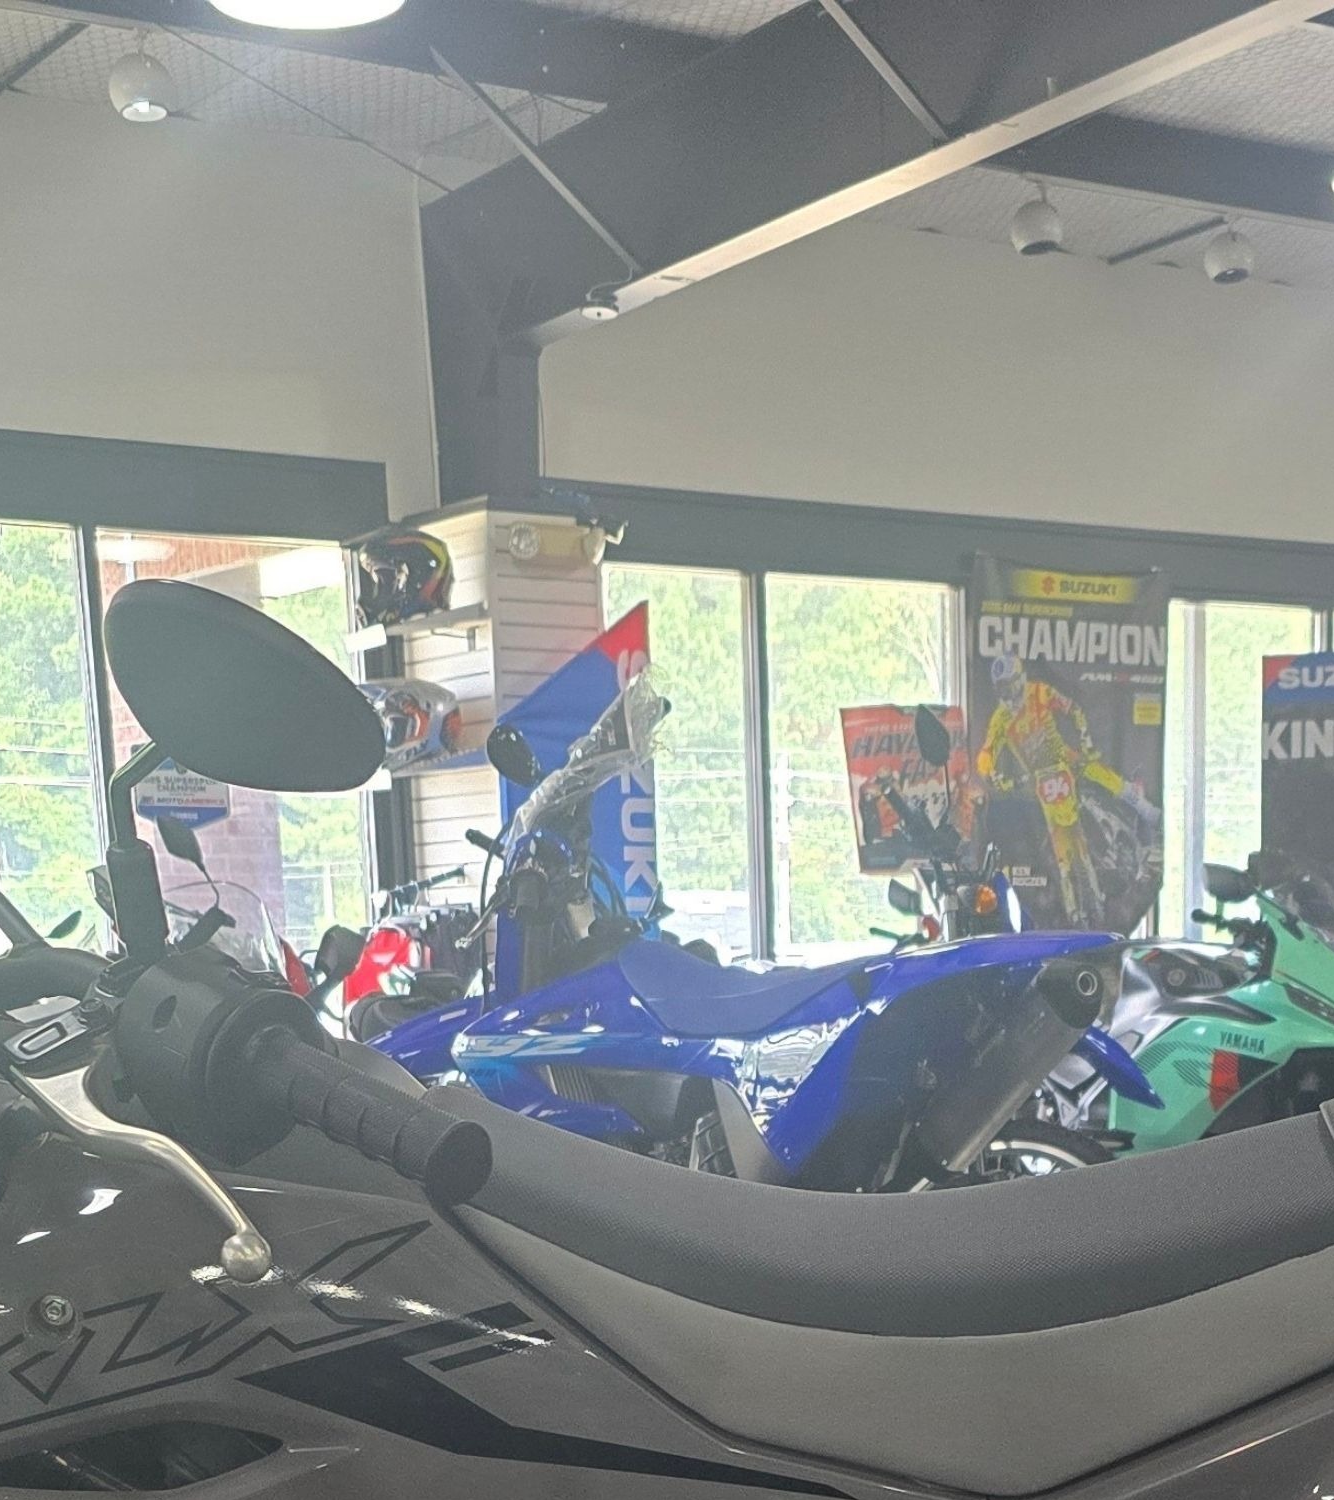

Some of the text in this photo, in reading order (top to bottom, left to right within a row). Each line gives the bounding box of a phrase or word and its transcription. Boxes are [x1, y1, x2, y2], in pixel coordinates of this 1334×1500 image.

[1059, 580, 1117, 596] SUZUKI
[978, 615, 1166, 667] CHAMPION
[1219, 1031, 1266, 1055] YAMAHA
